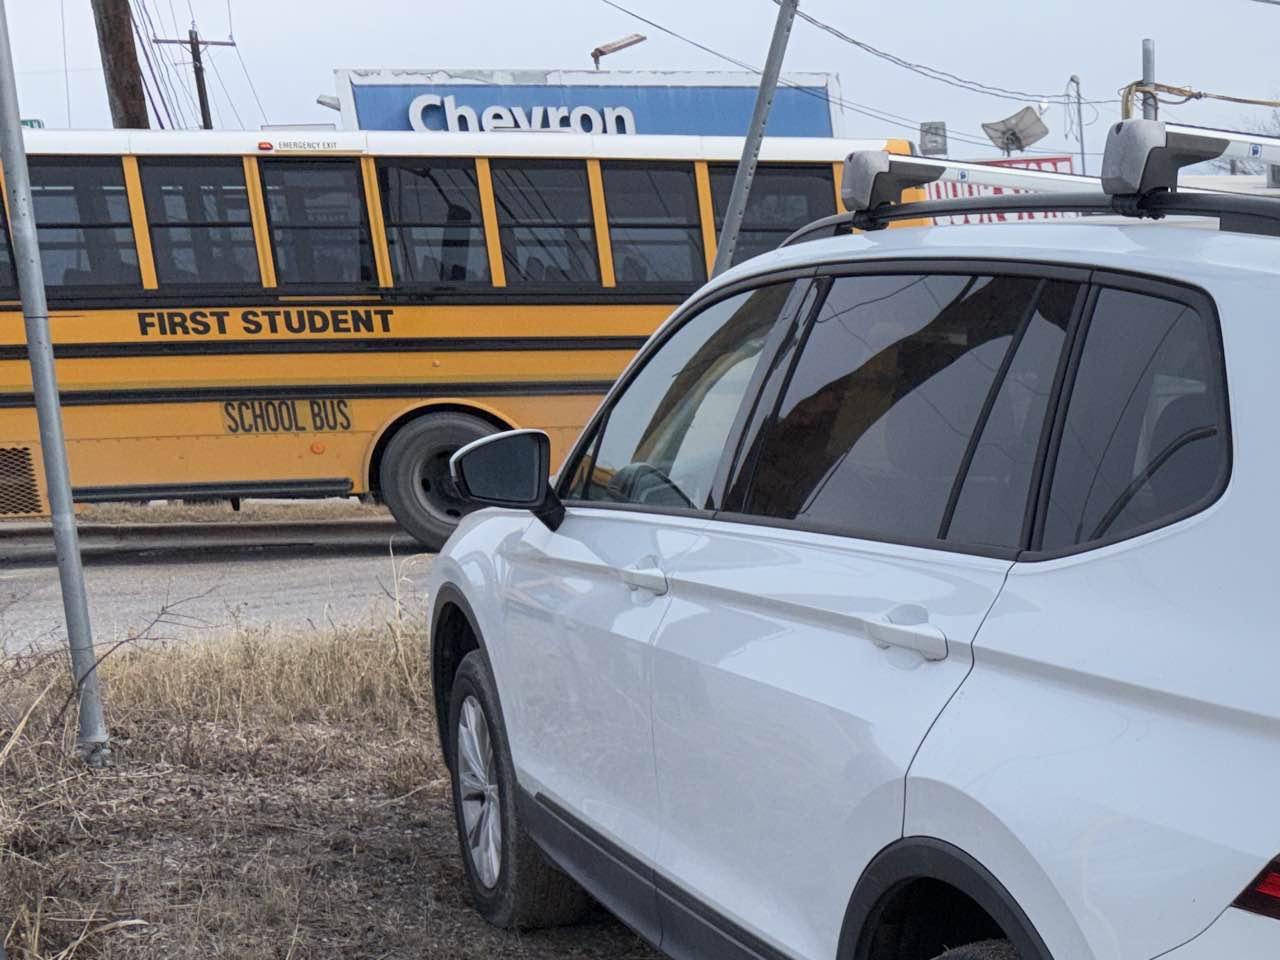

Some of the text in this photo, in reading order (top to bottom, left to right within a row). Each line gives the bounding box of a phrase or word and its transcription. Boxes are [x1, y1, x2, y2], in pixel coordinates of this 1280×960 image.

[408, 93, 636, 134] Chevron
[278, 141, 337, 150] EMERGENCY EXIT
[137, 309, 394, 336] FIRST STUDENT
[224, 400, 351, 433] SCHOOL BUS
